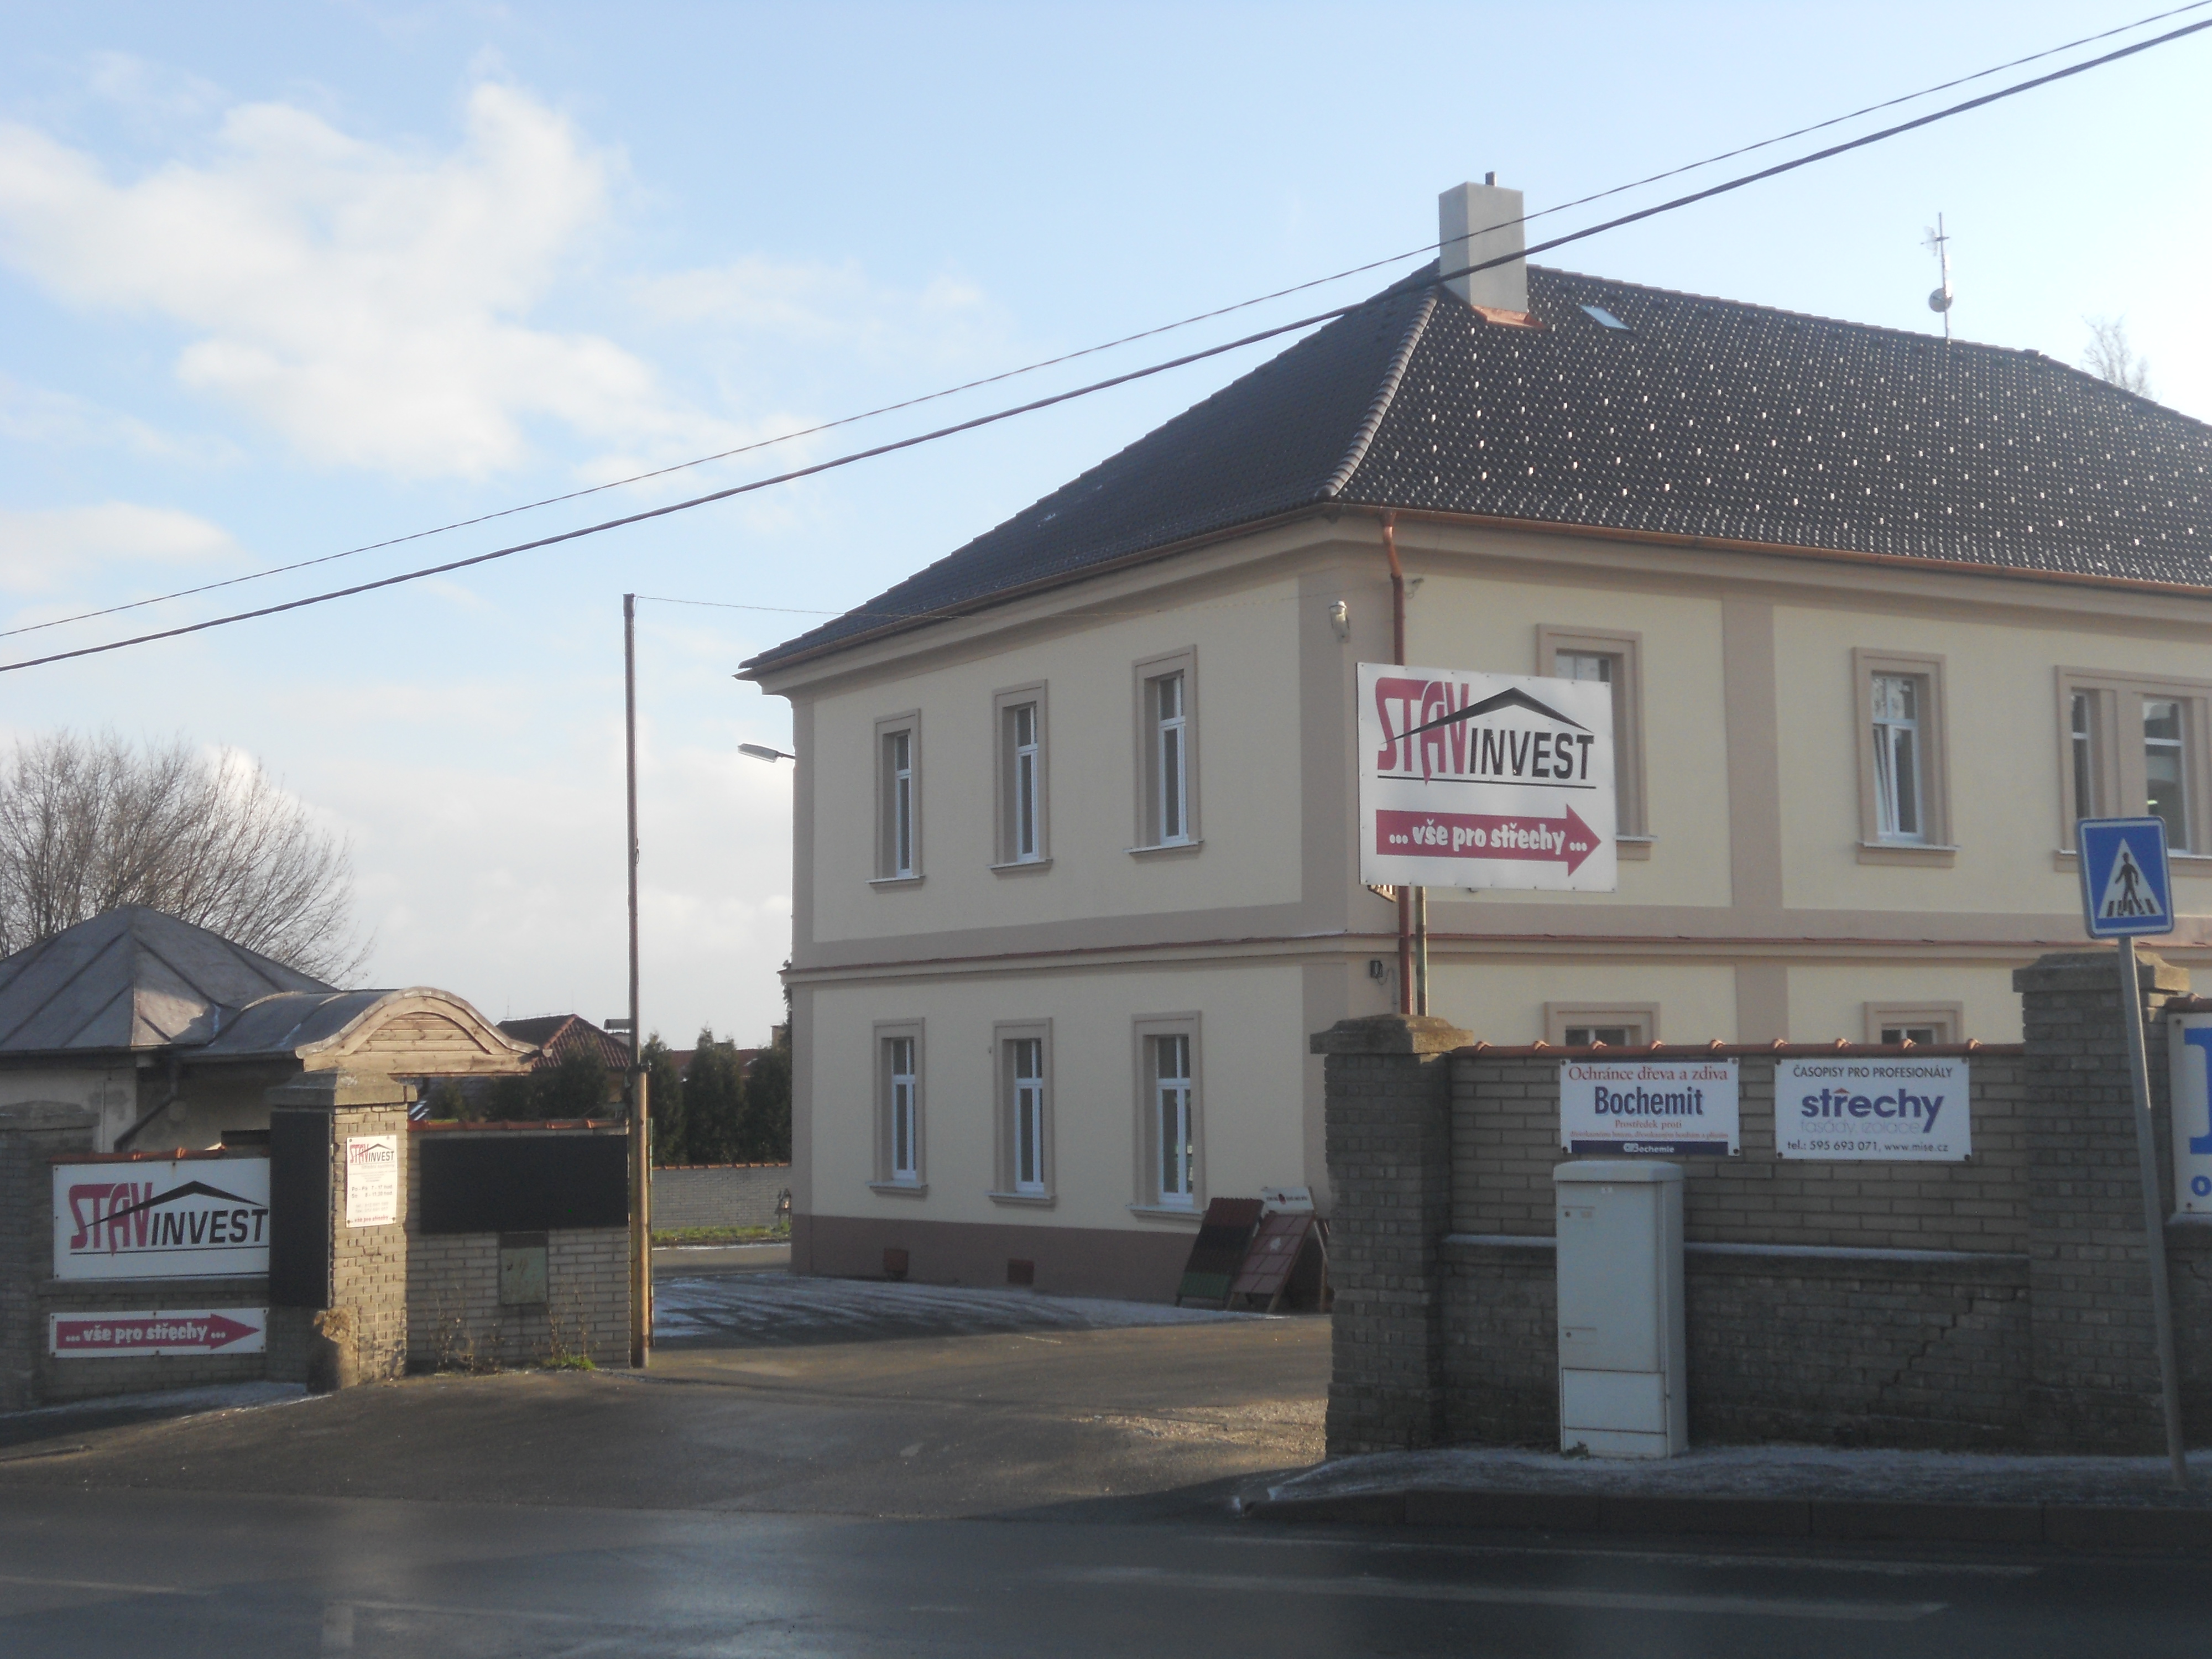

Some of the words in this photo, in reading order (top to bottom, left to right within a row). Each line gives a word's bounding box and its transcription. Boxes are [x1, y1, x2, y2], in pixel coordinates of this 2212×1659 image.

[1412, 819, 1448, 846] vše
[1453, 826, 1486, 852] pro
[1490, 823, 1566, 855] střechy
[1568, 1066, 1634, 1081] Ochránce
[1637, 1066, 1674, 1081] dřeva
[1679, 1071, 1687, 1080] a
[1692, 1066, 1728, 1081] zdiva
[1793, 1065, 1844, 1078] ČASOPISY
[1848, 1067, 1870, 1078] PRO
[1873, 1065, 1953, 1078] PROFESIONÁLY
[1595, 1086, 1703, 1115] Bochemit
[1801, 1087, 1945, 1133] střechy
[1661, 1120, 1682, 1130] proti
[1810, 1141, 1829, 1150] 595
[1834, 1141, 1854, 1150] 693
[84, 1325, 111, 1340] vše
[115, 1327, 142, 1344] pro
[146, 1322, 207, 1342] střechy
